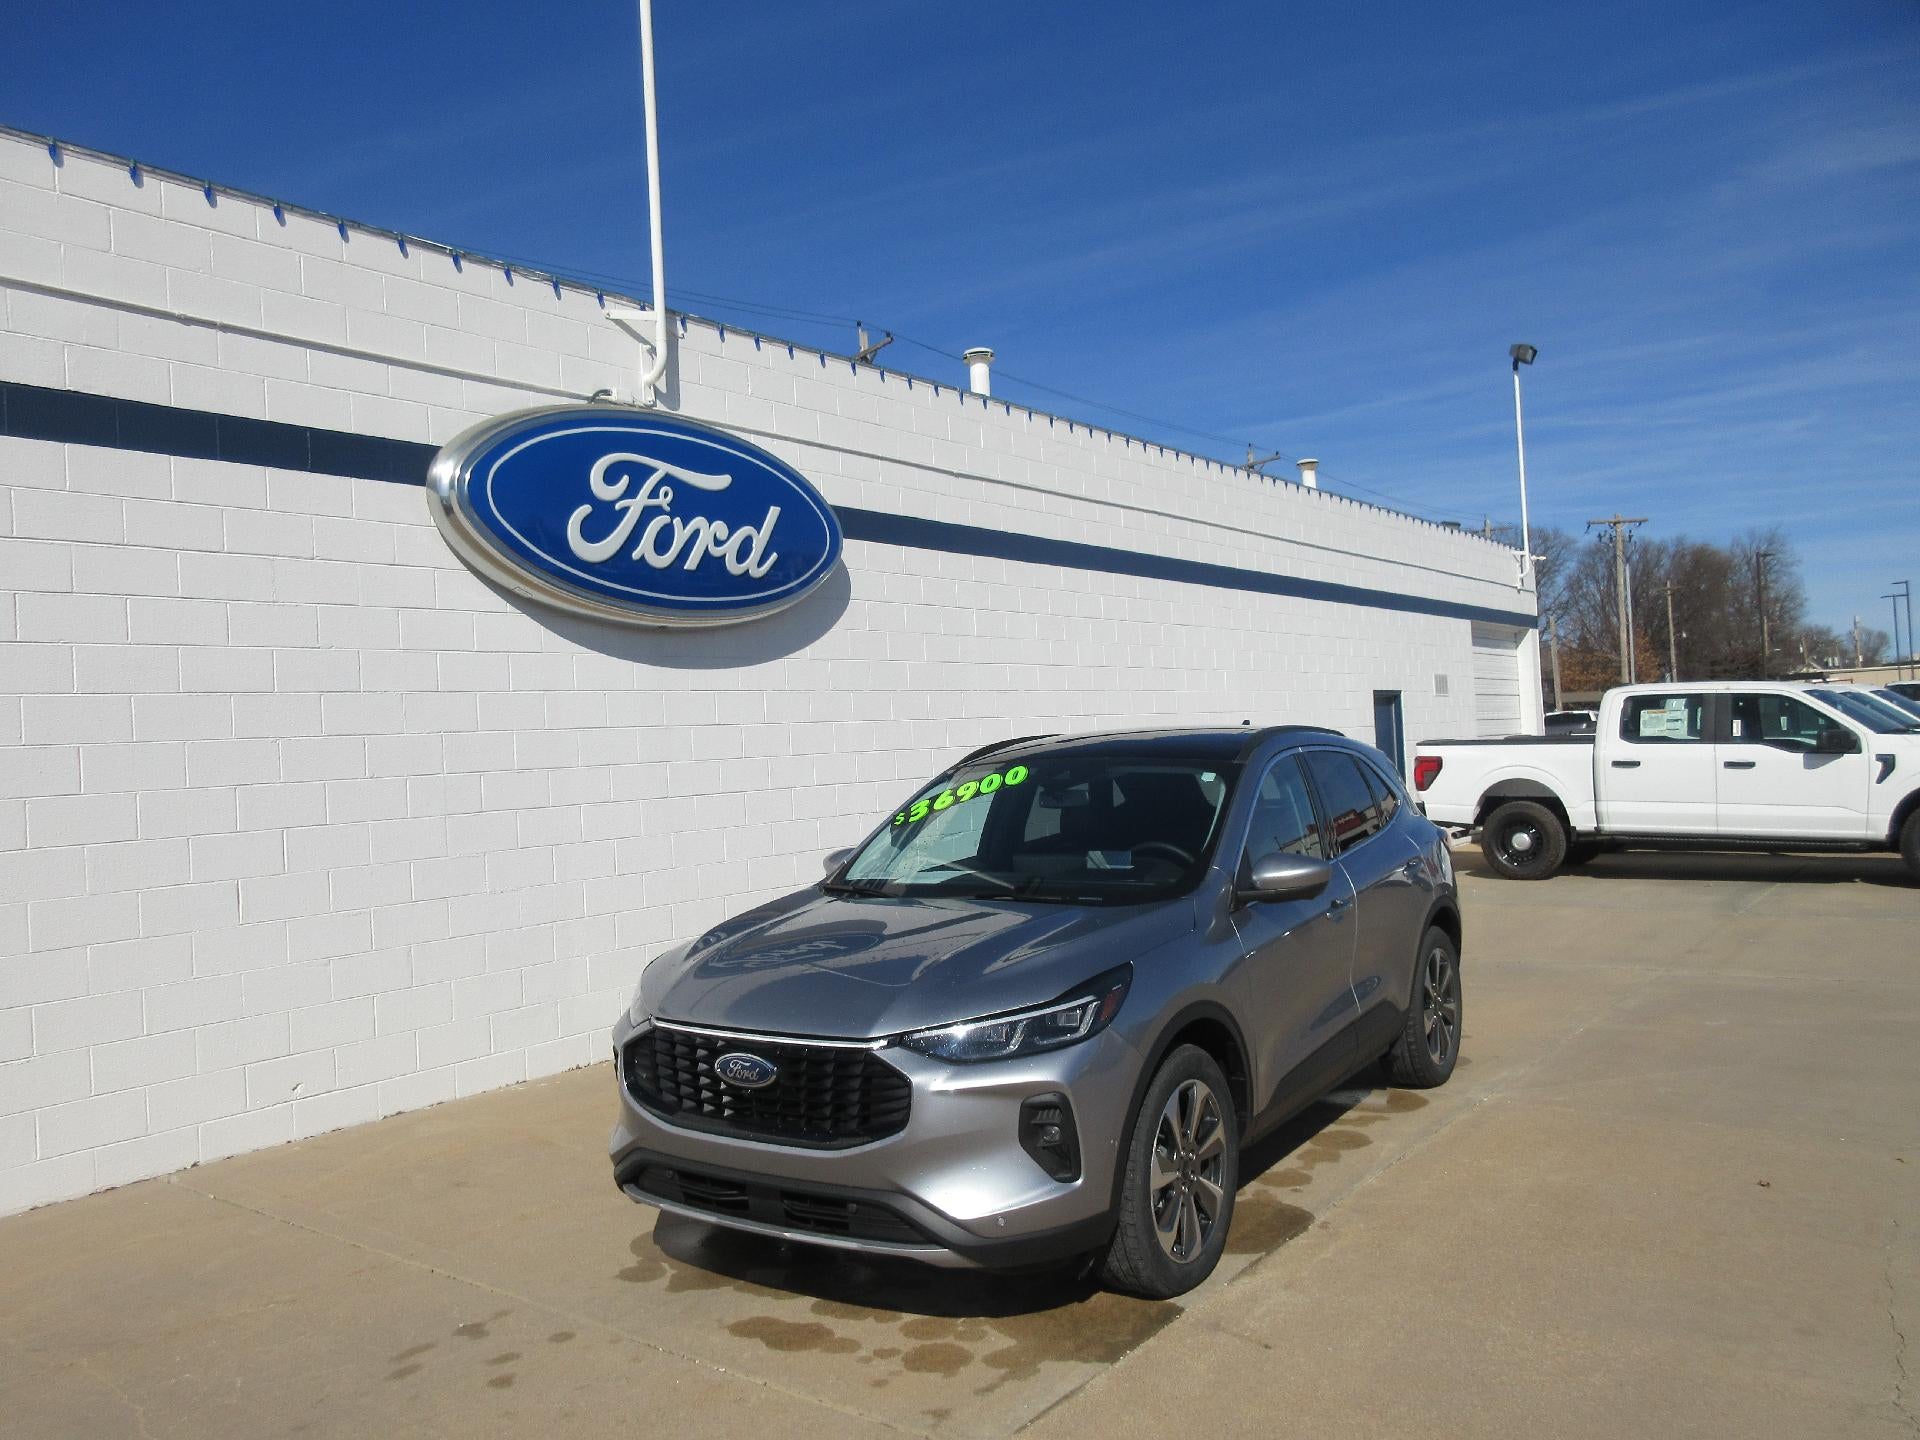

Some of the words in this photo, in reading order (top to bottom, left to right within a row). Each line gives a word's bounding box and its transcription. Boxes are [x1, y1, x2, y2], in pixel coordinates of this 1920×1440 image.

[566, 452, 781, 578] Ford
[893, 765, 1029, 825] $36900
[727, 1059, 759, 1080] Ford
